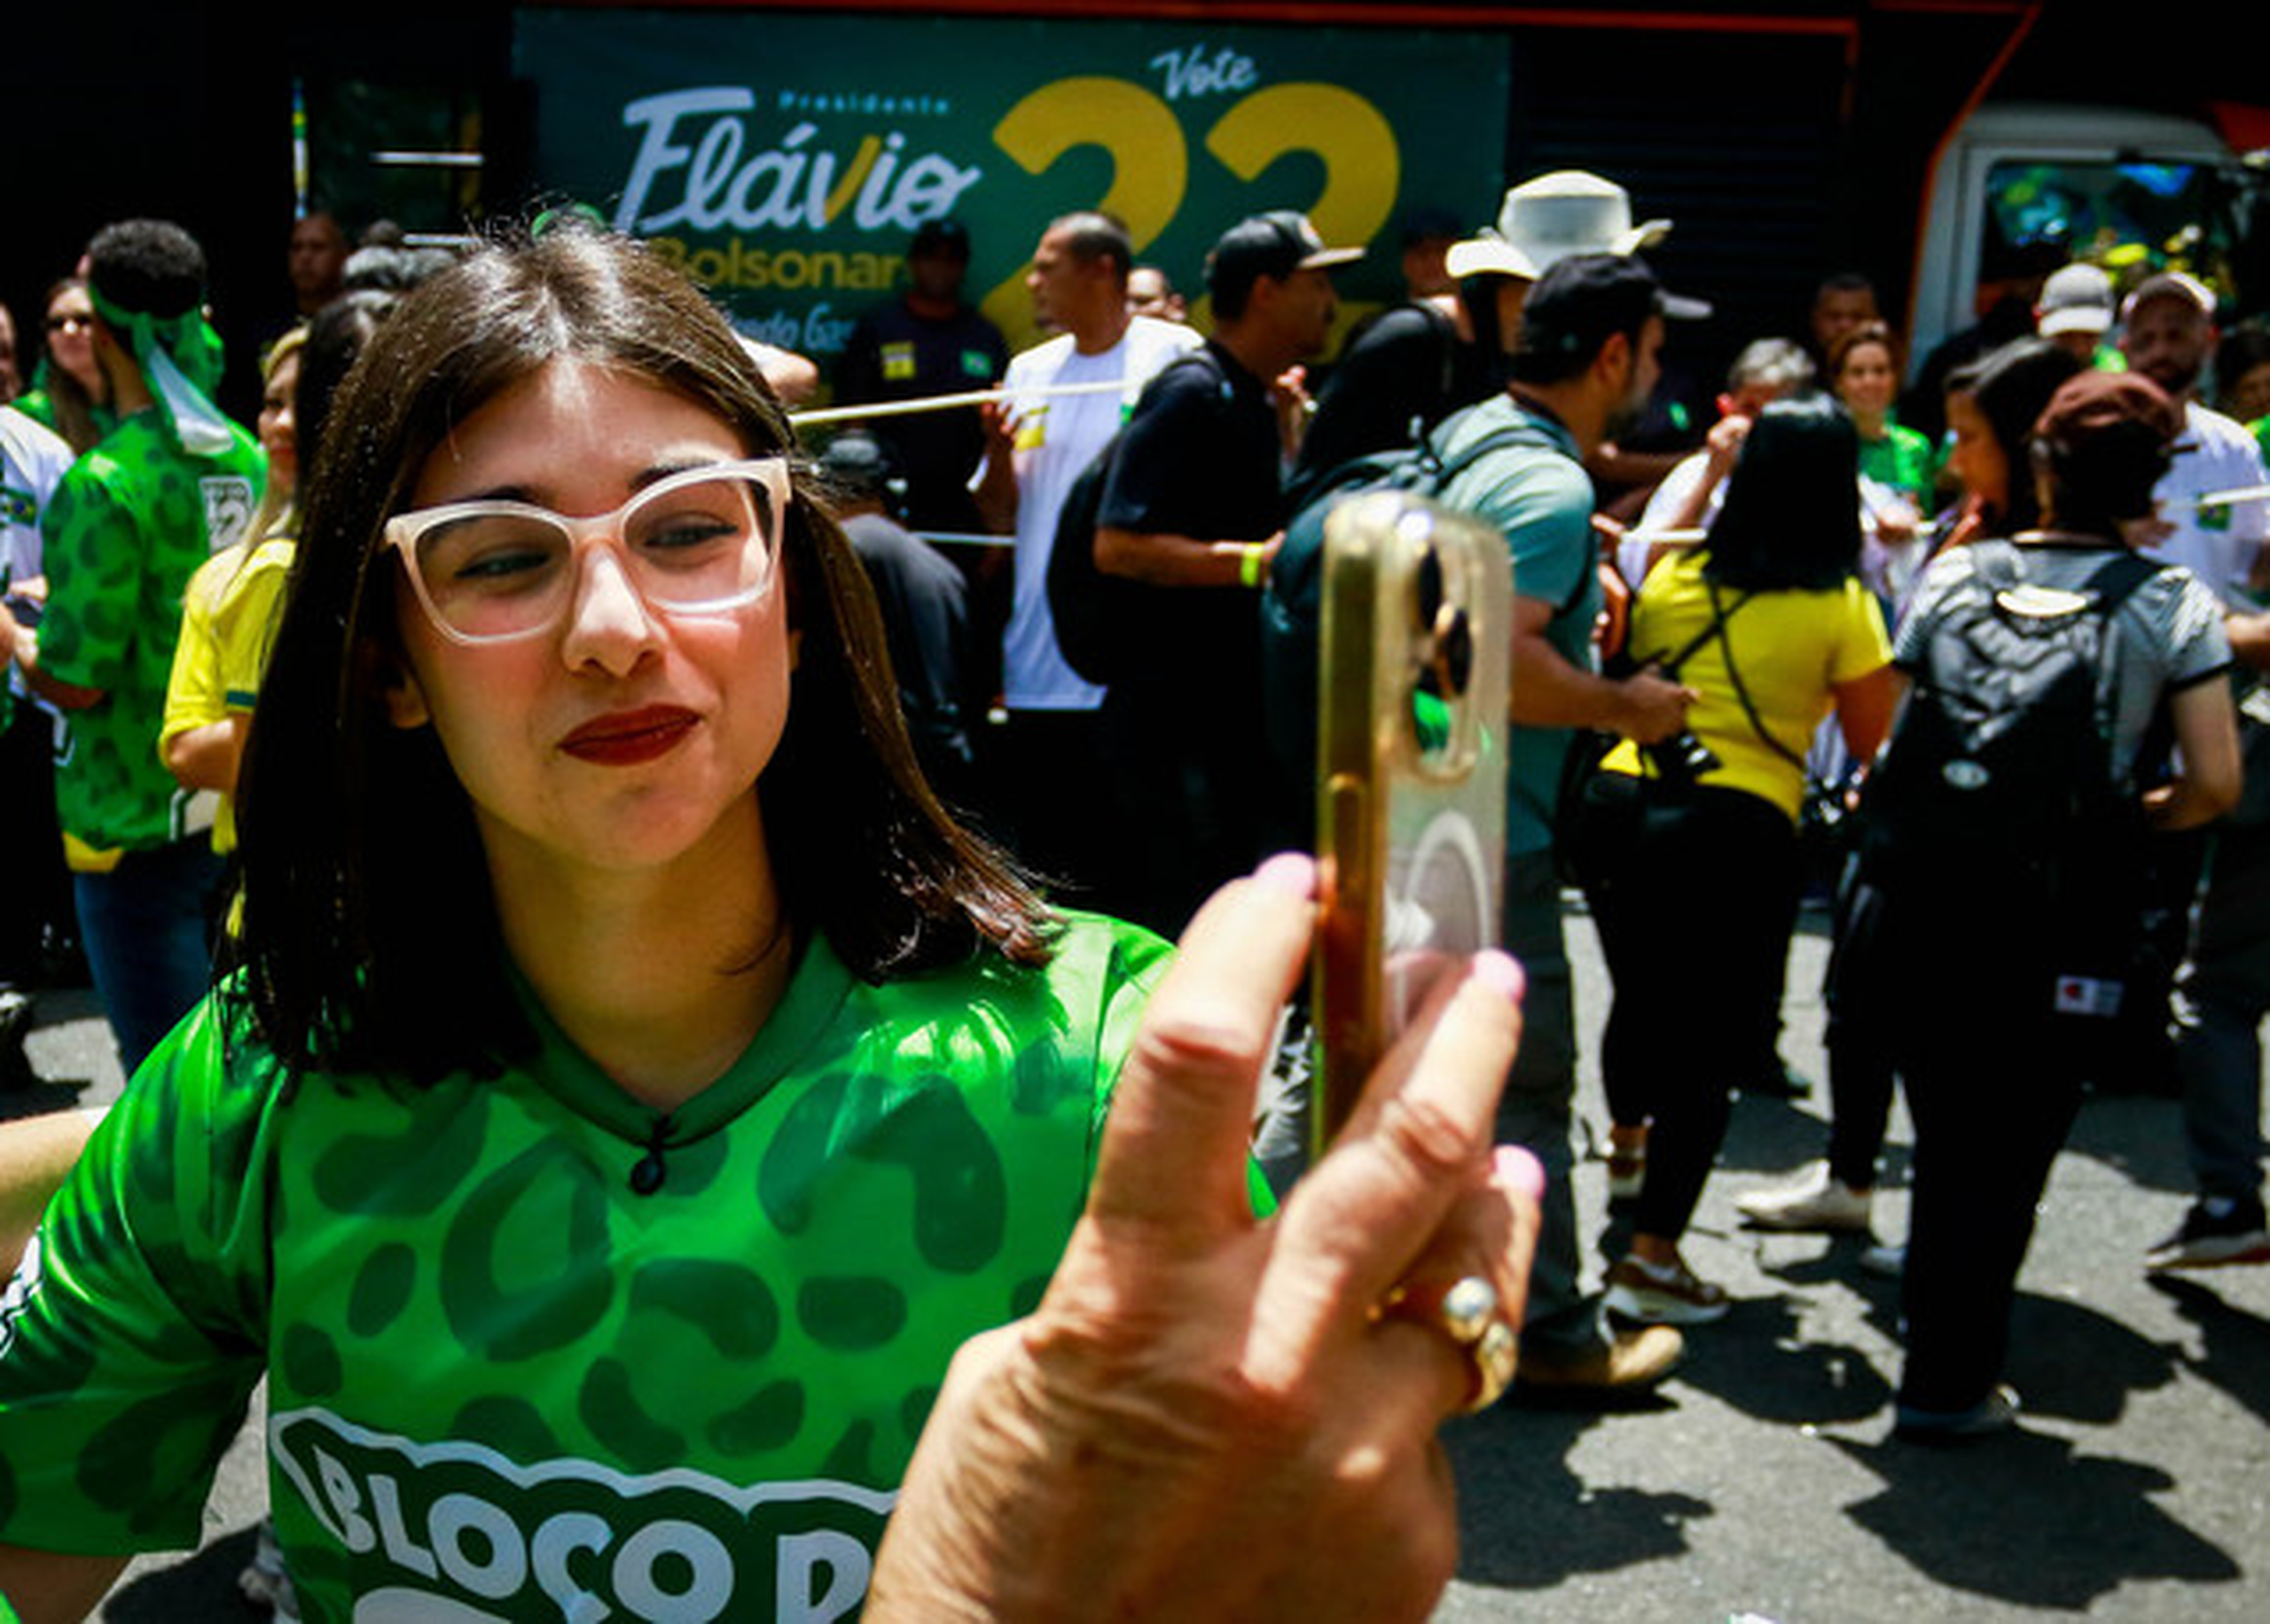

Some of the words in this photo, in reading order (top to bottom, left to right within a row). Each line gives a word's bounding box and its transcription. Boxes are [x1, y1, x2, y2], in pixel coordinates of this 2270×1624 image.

[779, 91, 948, 114] Presidente
[1150, 44, 1257, 100] Vote
[615, 87, 982, 230] Flávio
[982, 76, 1399, 365] 22
[646, 238, 913, 289] Bolsonar
[777, 1529, 873, 1624] D
